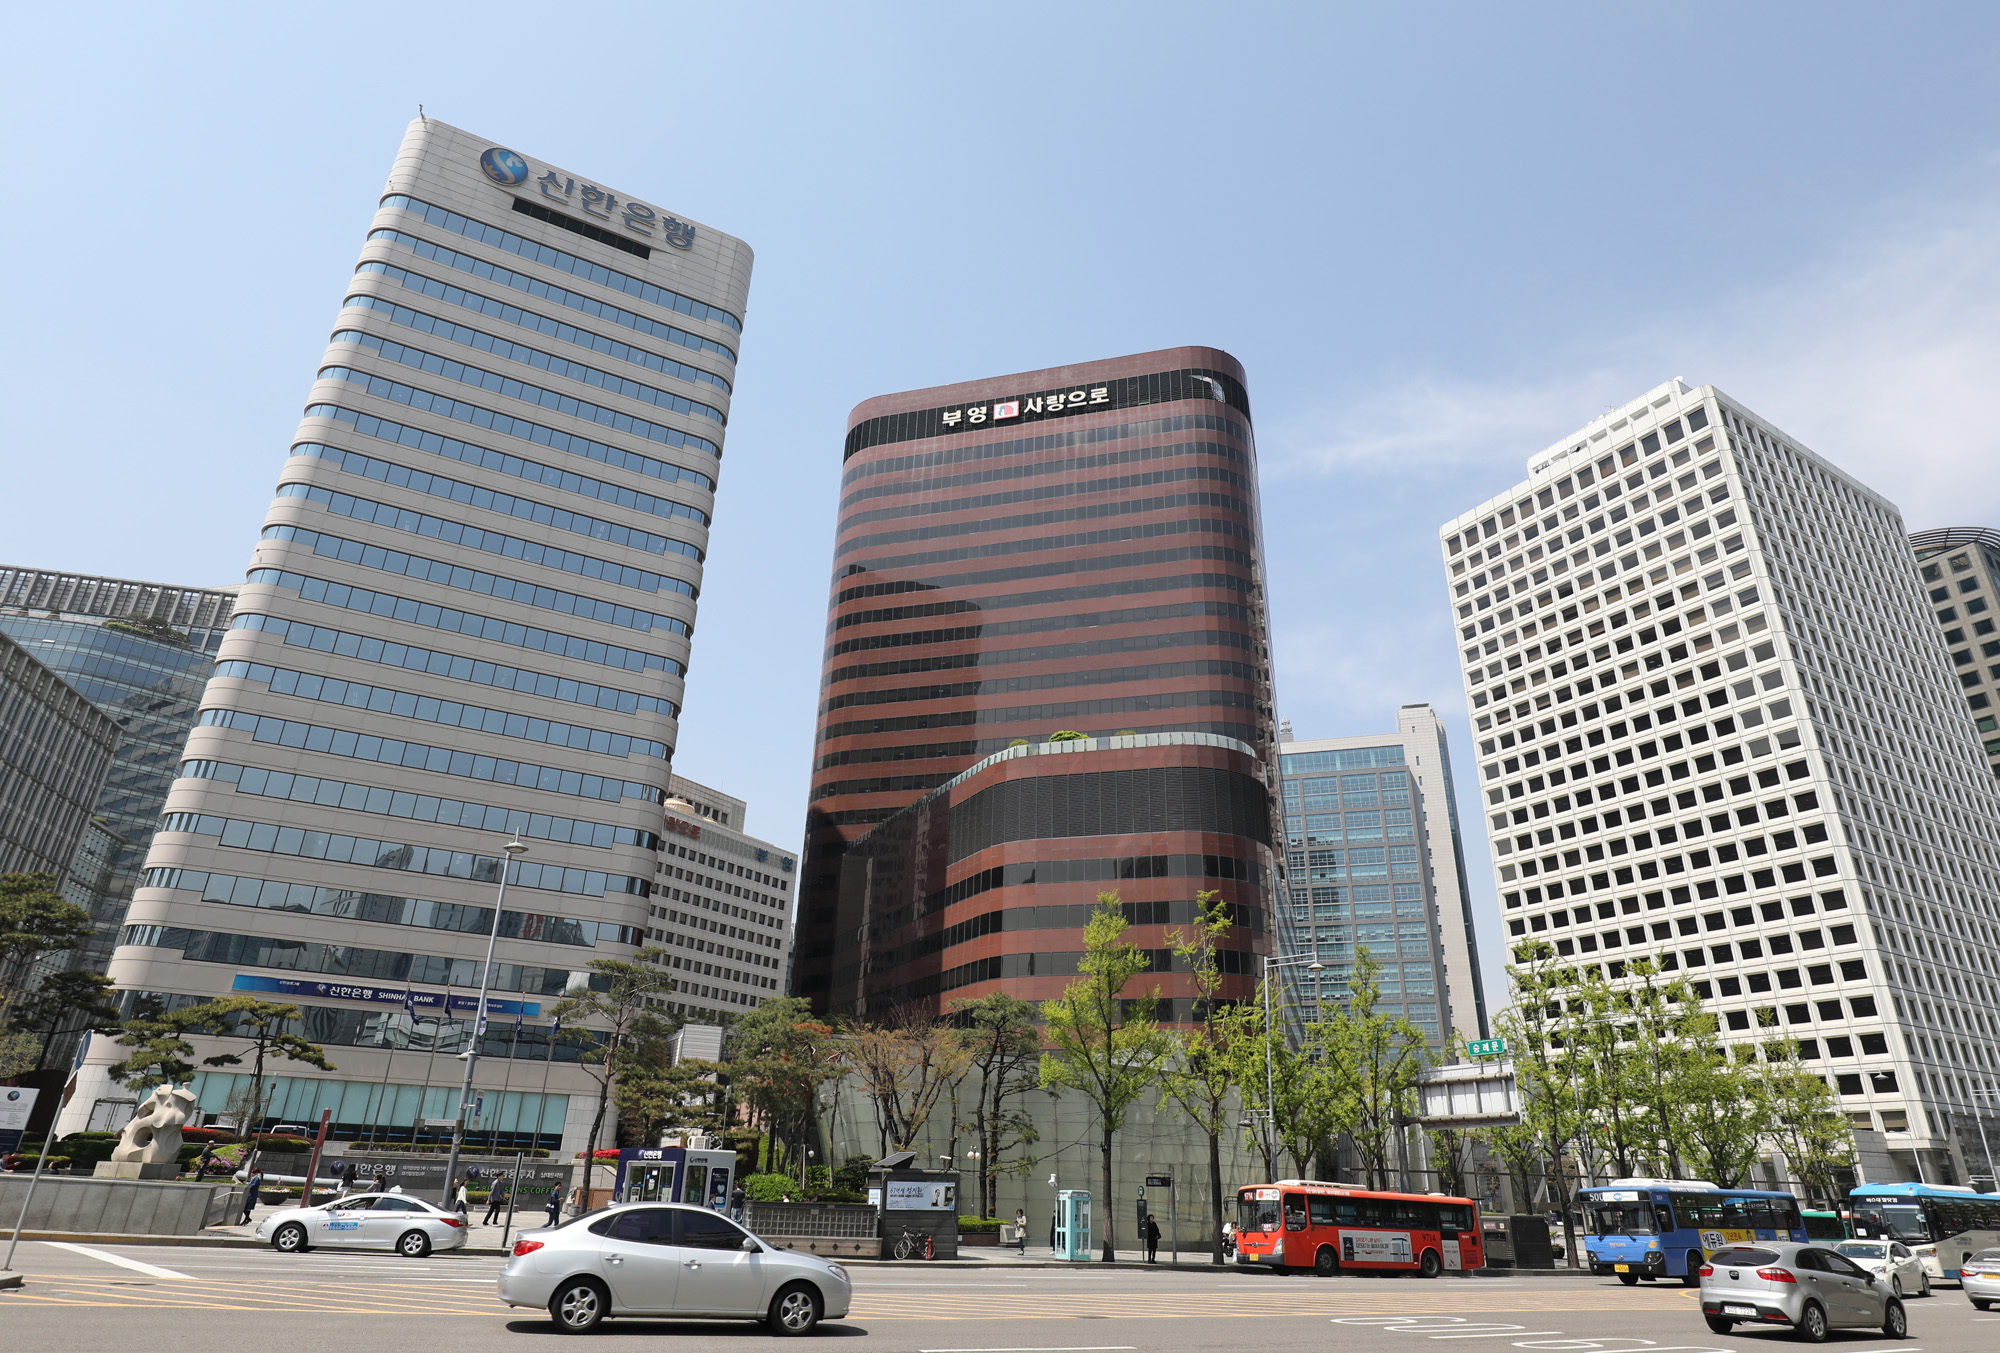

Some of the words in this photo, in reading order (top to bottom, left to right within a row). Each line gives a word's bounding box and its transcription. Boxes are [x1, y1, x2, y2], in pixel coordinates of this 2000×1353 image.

[537, 170, 696, 250] 신한은행
[1023, 387, 1110, 415] 사랑으로
[664, 815, 701, 839] 랑으로
[329, 986, 373, 999] 신한은행
[378, 991, 407, 1001] SHINHA
[413, 995, 434, 1004] BANK
[1472, 1041, 1499, 1053] 숭례문
[1422, 1233, 1436, 1241] 9714
